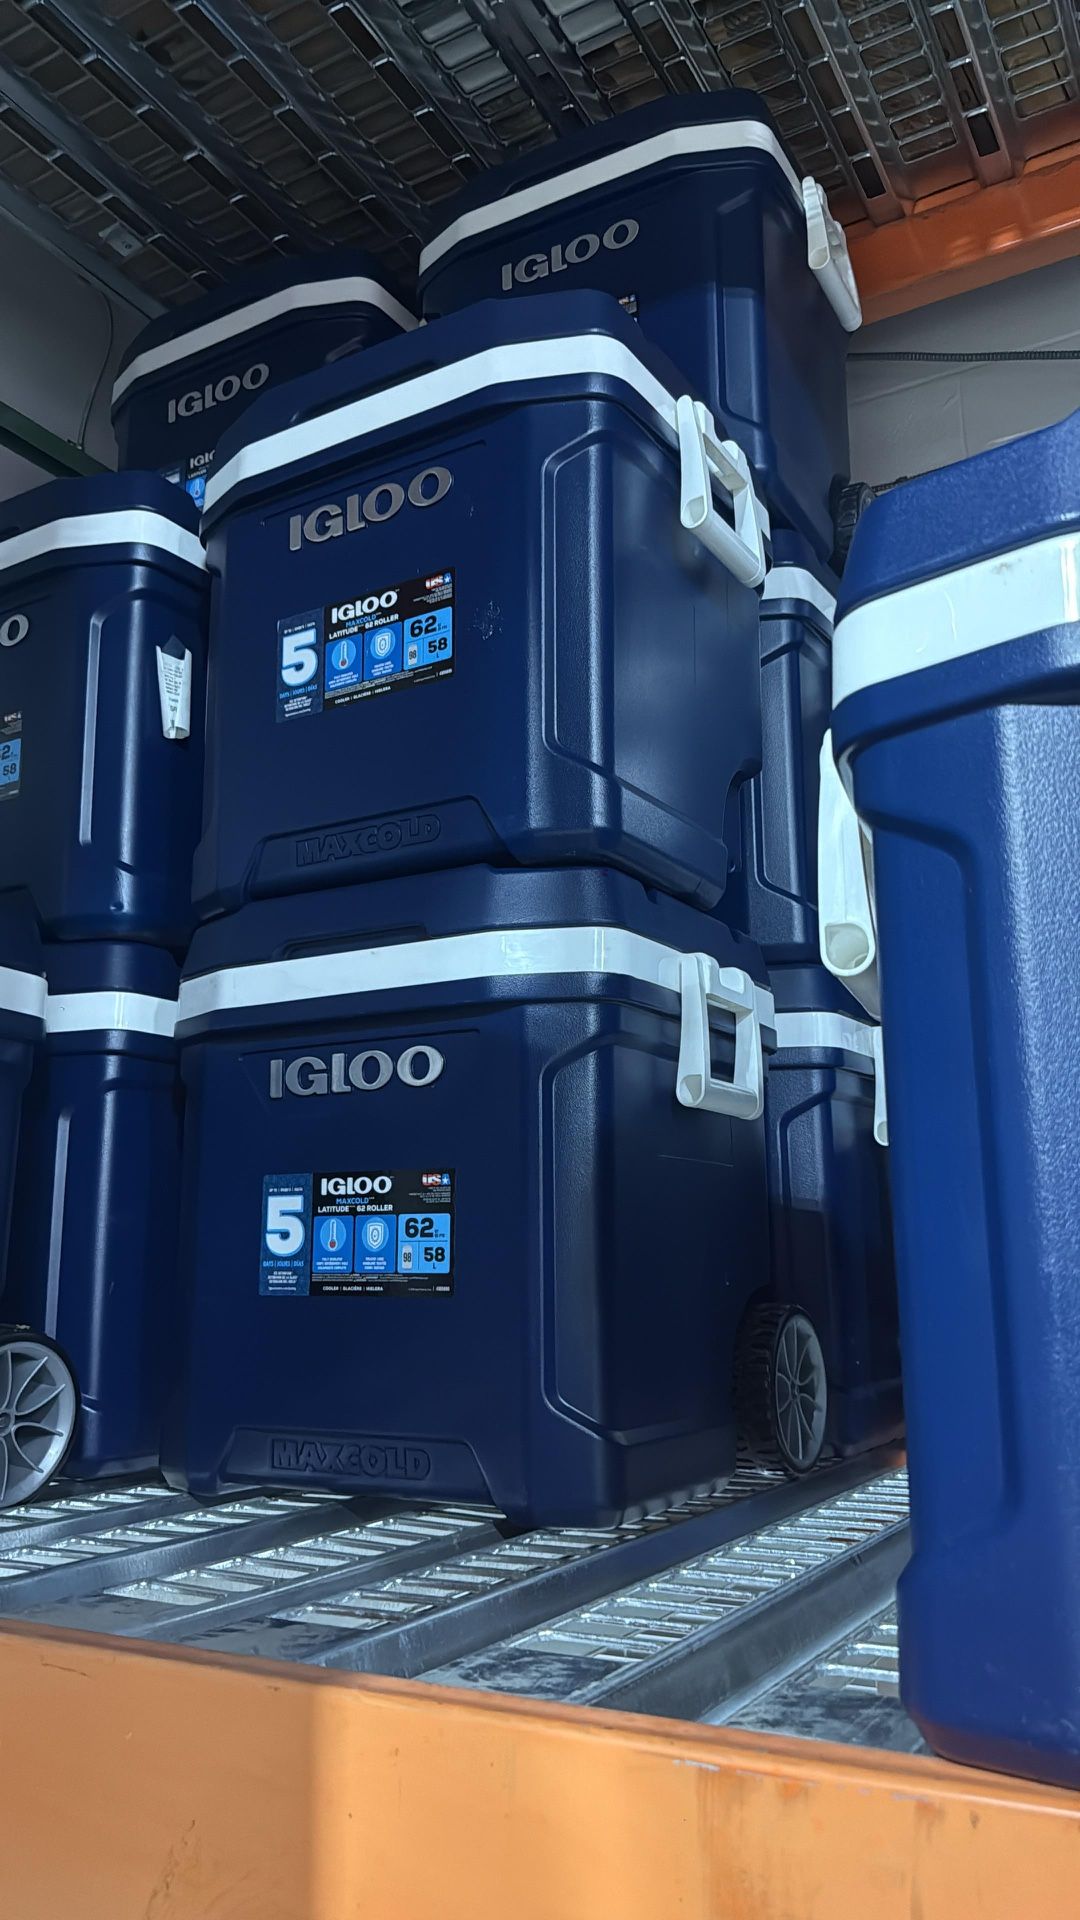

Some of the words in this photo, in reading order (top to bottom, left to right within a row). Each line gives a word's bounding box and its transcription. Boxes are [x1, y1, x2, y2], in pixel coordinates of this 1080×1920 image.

[502, 219, 640, 291] IGLOO
[168, 363, 270, 423] IGLOO
[290, 466, 453, 551] IGLOO
[331, 590, 398, 624] IGLOO
[328, 625, 359, 640] LATITUDE
[364, 620, 374, 629] 62
[374, 613, 399, 627] ROLLER
[345, 614, 377, 628] MAXCOLD
[409, 615, 438, 638] 62
[281, 627, 319, 687] 5
[428, 637, 448, 654] 58
[3, 763, 17, 776] 58
[295, 814, 441, 867] MAXCOLD
[270, 1045, 444, 1098] IGLOO
[321, 1176, 392, 1196] IGLOO
[422, 1173, 451, 1187] USA
[317, 1205, 350, 1213] LATITUDE
[366, 1204, 393, 1212] ROLLER
[335, 1197, 369, 1205] MAXCOLD
[266, 1195, 305, 1257] 5
[405, 1217, 434, 1238] 62
[403, 1252, 412, 1263] 98
[424, 1246, 446, 1262] 58
[271, 1438, 431, 1481] MAXCOLD
